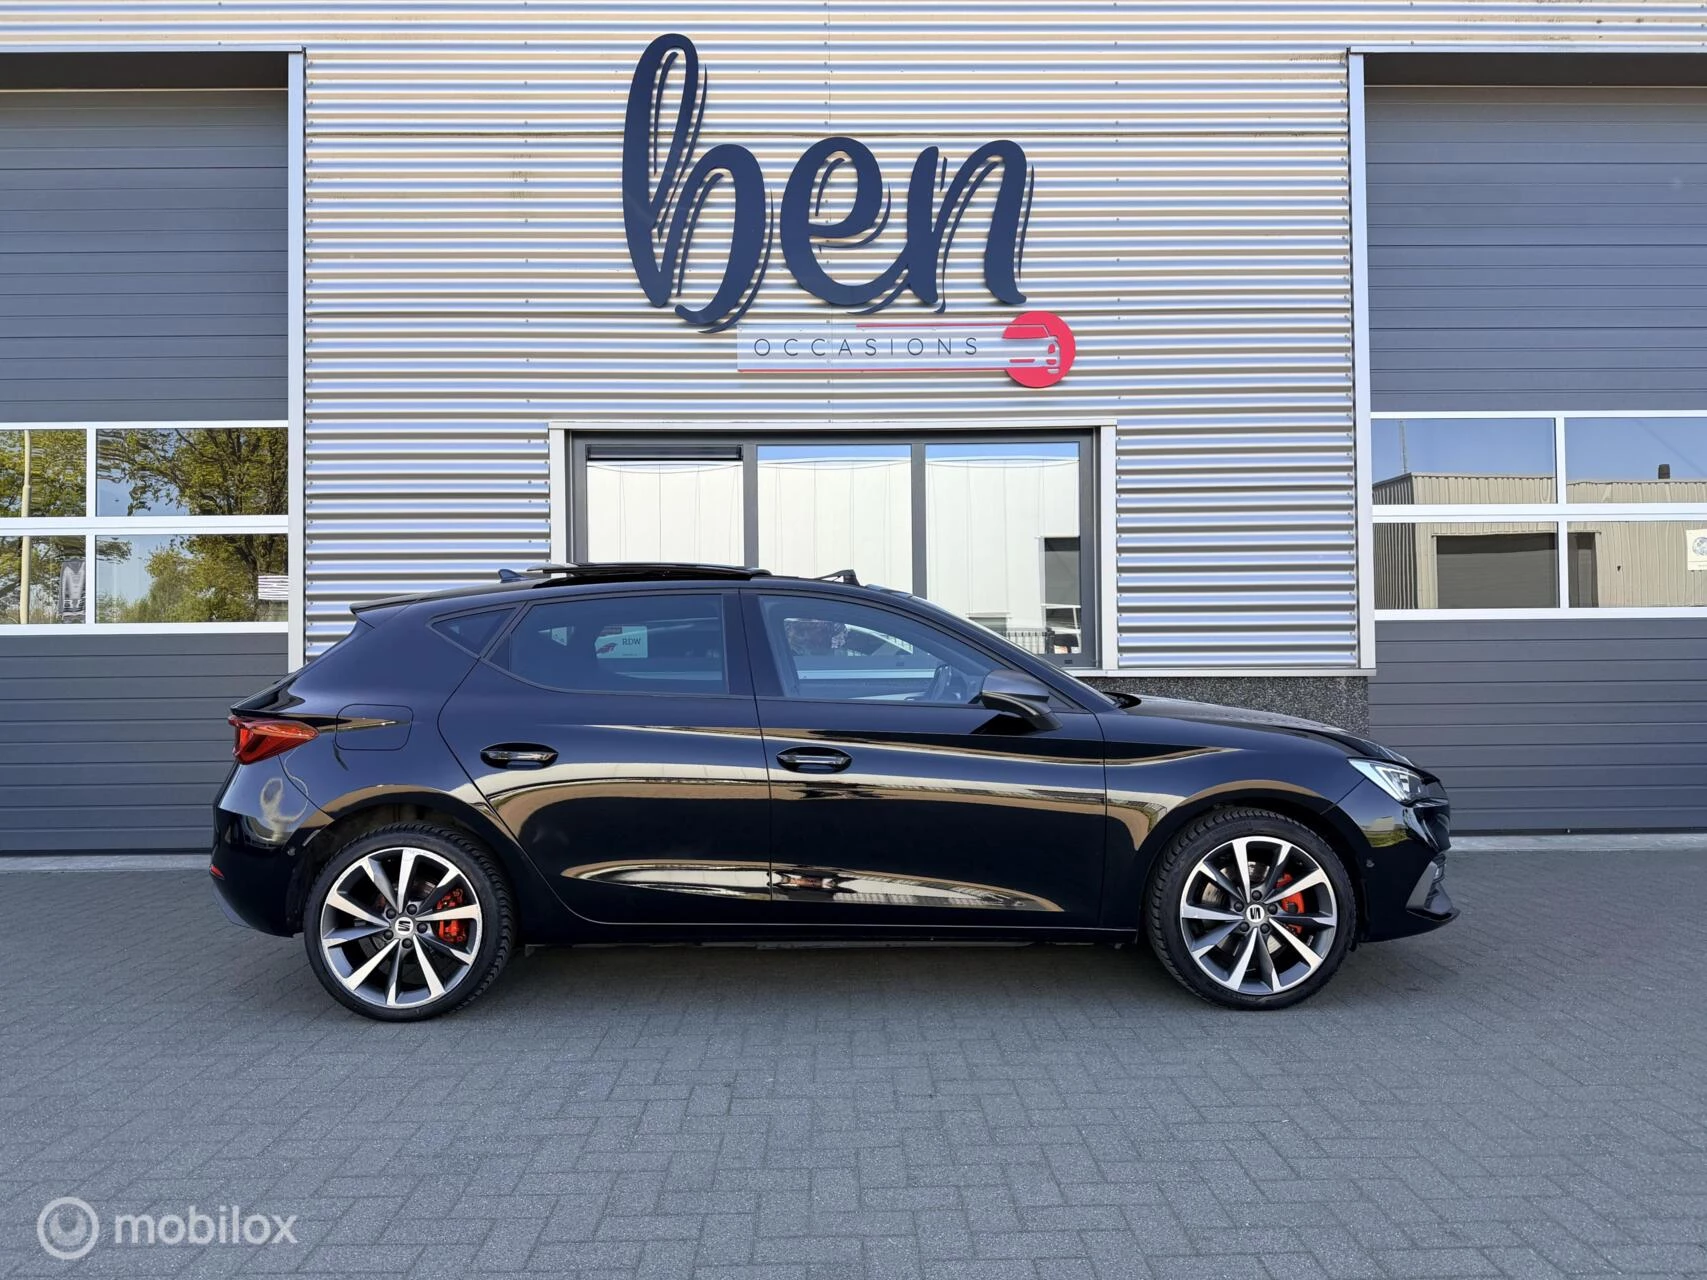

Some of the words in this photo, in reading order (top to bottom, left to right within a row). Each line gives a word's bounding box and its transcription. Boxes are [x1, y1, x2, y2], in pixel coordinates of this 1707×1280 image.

[622, 33, 1034, 333] ben
[753, 338, 977, 356] OCCASIONS
[622, 638, 641, 646] RDW
